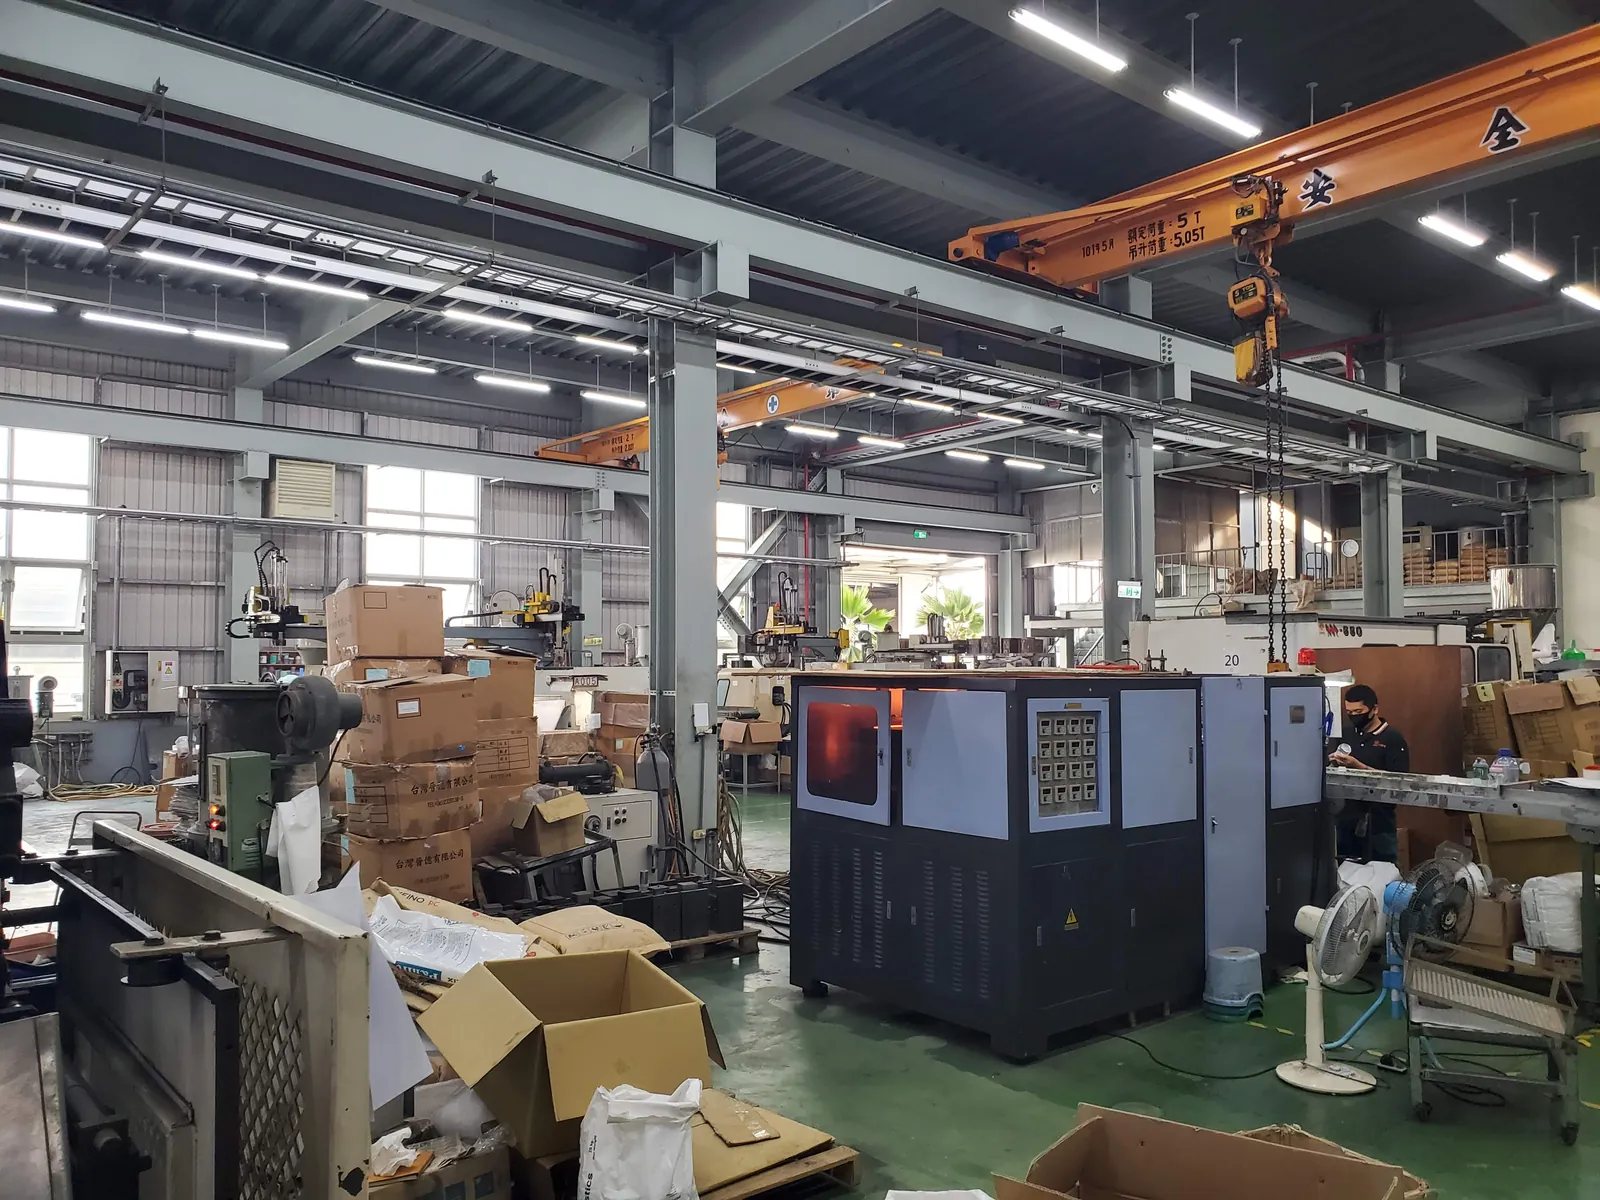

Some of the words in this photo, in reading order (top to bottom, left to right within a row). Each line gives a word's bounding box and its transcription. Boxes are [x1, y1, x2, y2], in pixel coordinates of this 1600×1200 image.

[1299, 168, 1337, 211] 安
[1479, 106, 1530, 153] 全
[1177, 212, 1188, 228] 5
[1194, 210, 1201, 224] T
[1224, 654, 1240, 666] 20
